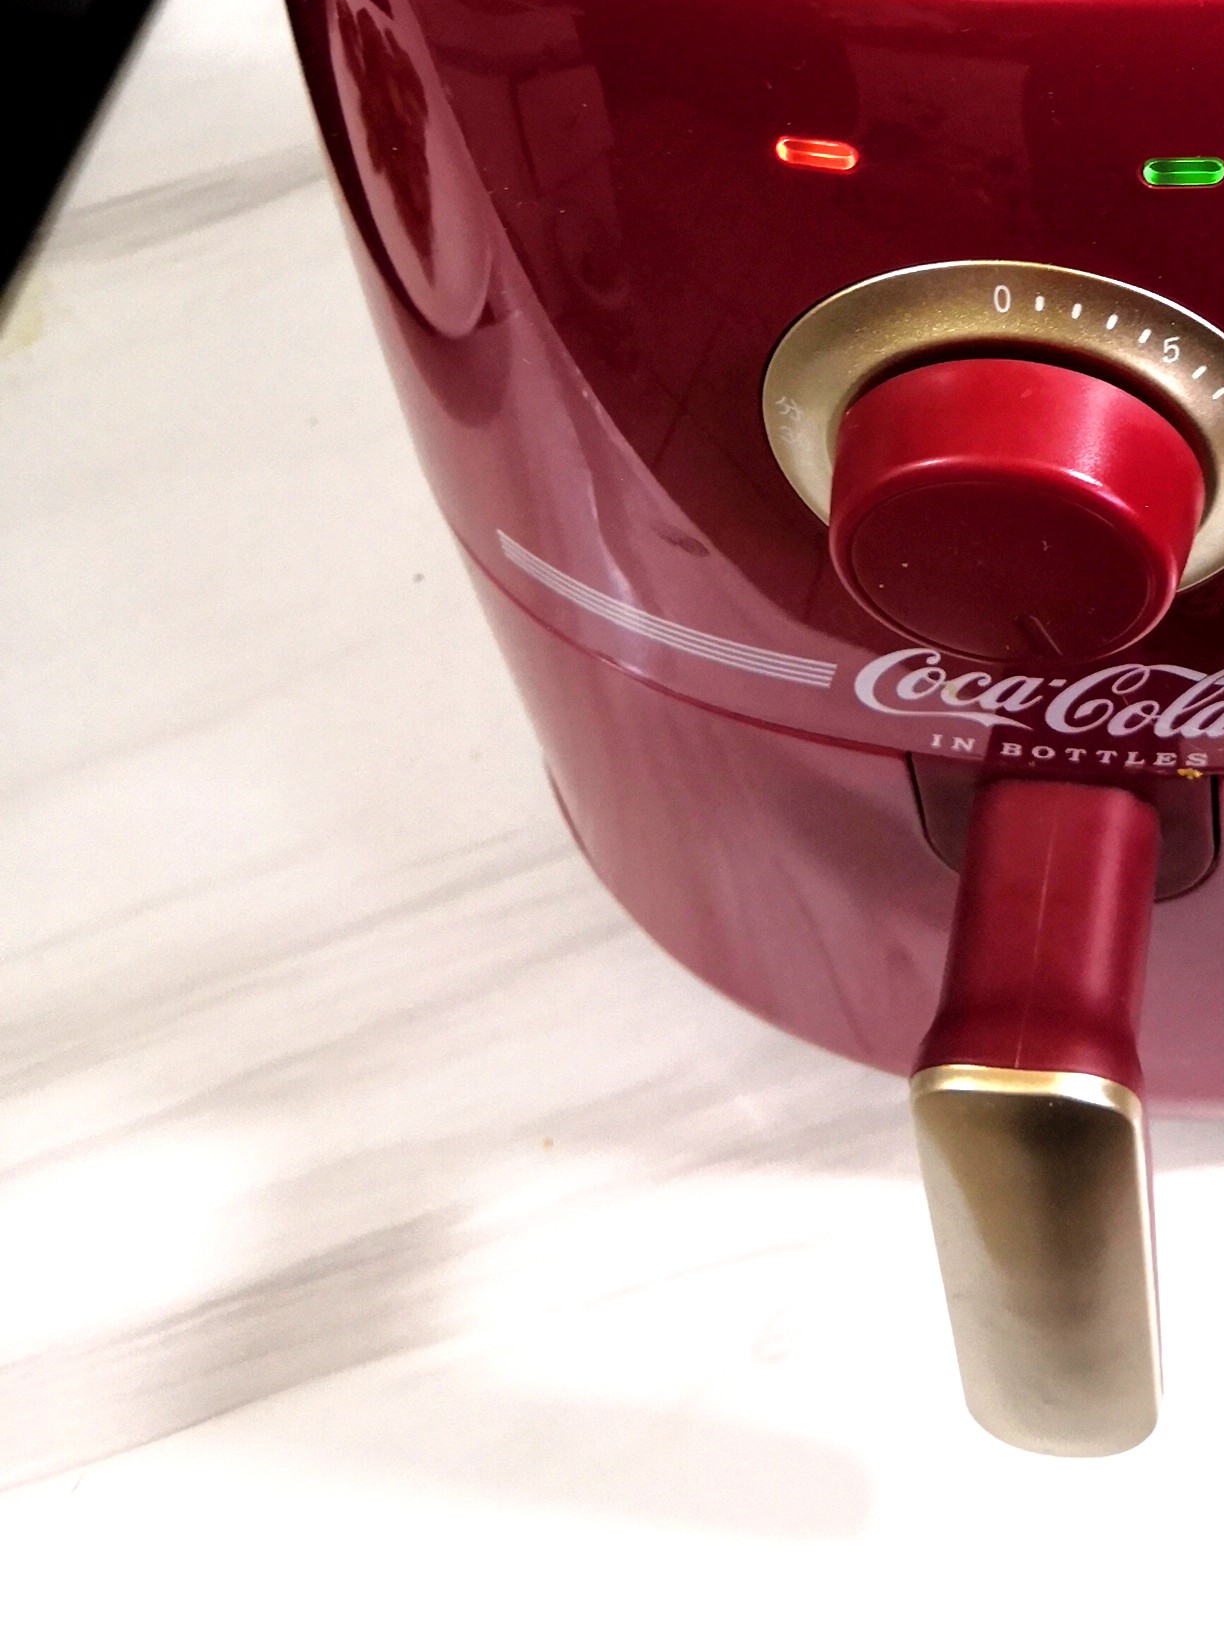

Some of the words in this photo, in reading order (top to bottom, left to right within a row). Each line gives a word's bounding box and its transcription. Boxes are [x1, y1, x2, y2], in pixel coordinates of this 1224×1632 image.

[993, 285, 1012, 314] 0
[1162, 337, 1181, 364] 5
[932, 733, 976, 751] IN
[1001, 742, 1209, 767] BOTTLES
